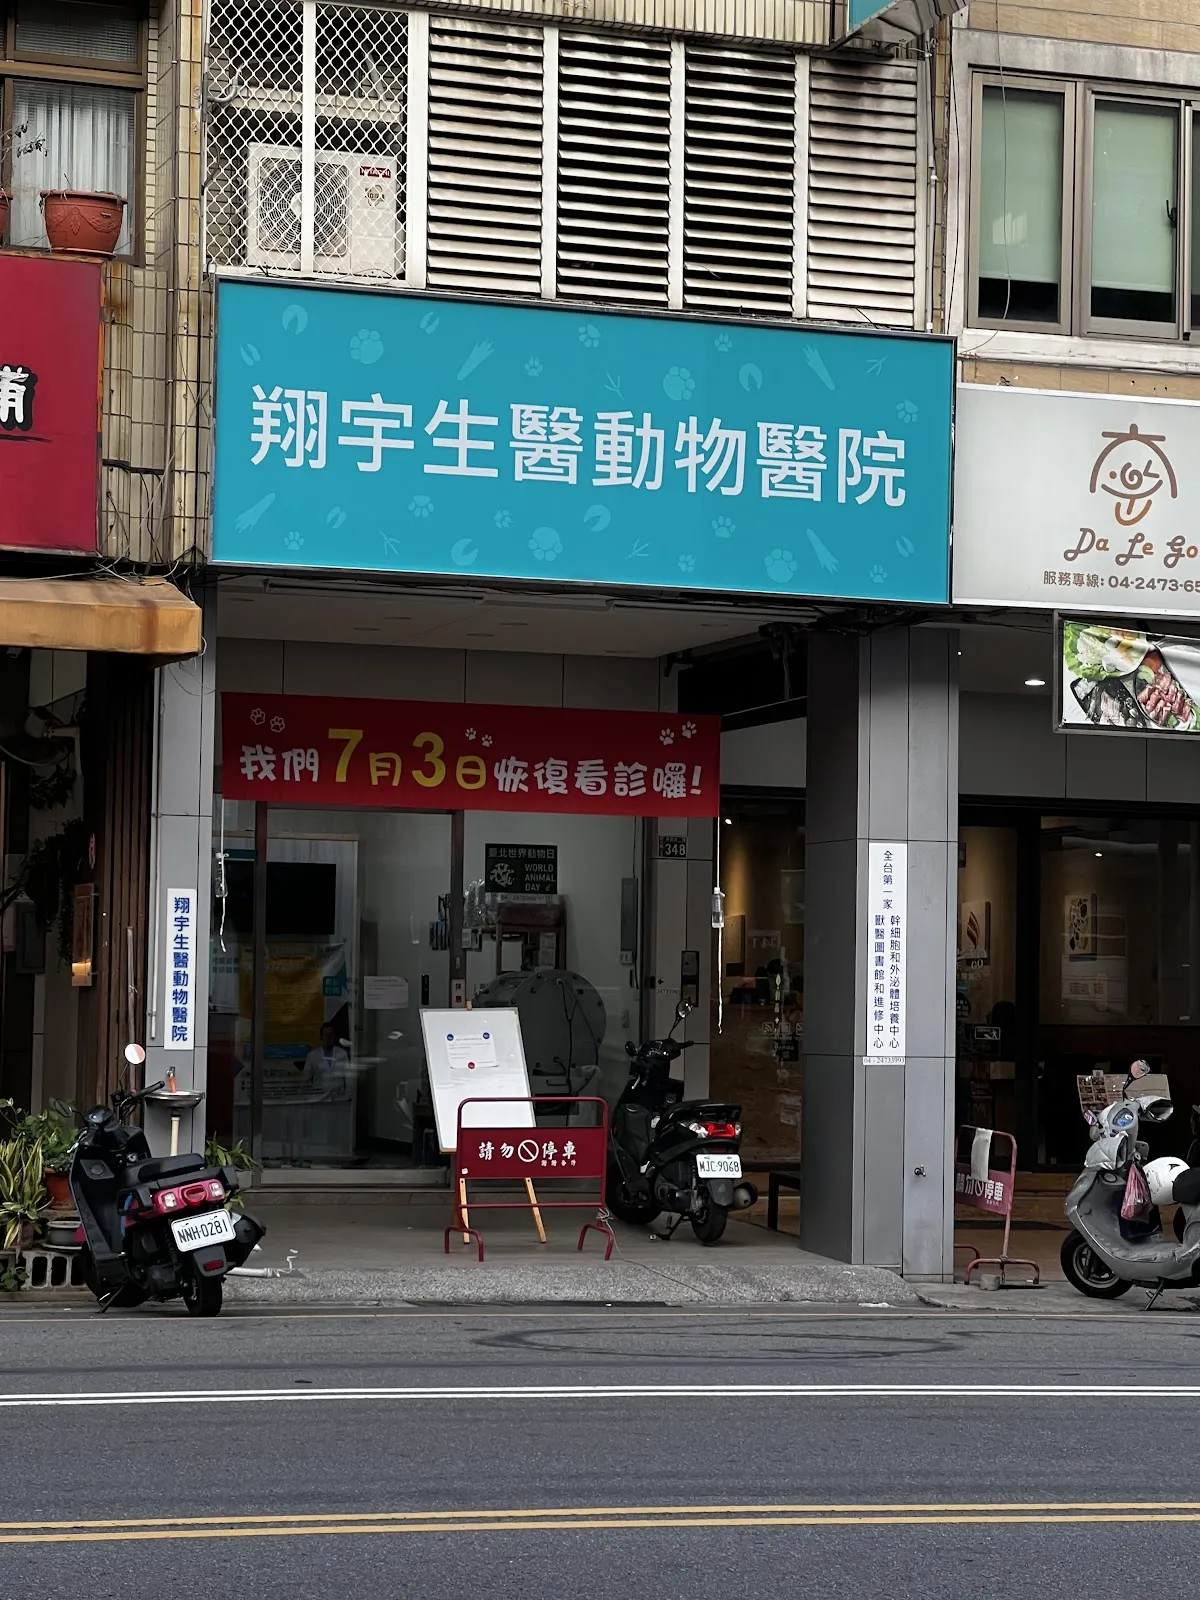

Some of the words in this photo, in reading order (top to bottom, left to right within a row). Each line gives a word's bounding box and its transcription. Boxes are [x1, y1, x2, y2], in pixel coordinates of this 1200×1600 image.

[250, 384, 906, 507] 翔宇生醫動物醫院
[1063, 527, 1110, 562] Da
[1114, 532, 1154, 567] Le
[1163, 535, 1199, 569] Go
[664, 843, 686, 856] 348
[524, 863, 554, 873] WORLD
[524, 873, 557, 883] ANIMAL
[524, 883, 541, 892] DAY
[882, 850, 894, 910] 全台第一家
[171, 897, 190, 1042] 翔宇生醫動物醫院
[478, 1141, 514, 1160] 請勿
[541, 1140, 577, 1160] 停車
[177, 1218, 228, 1244] NNH-0281
